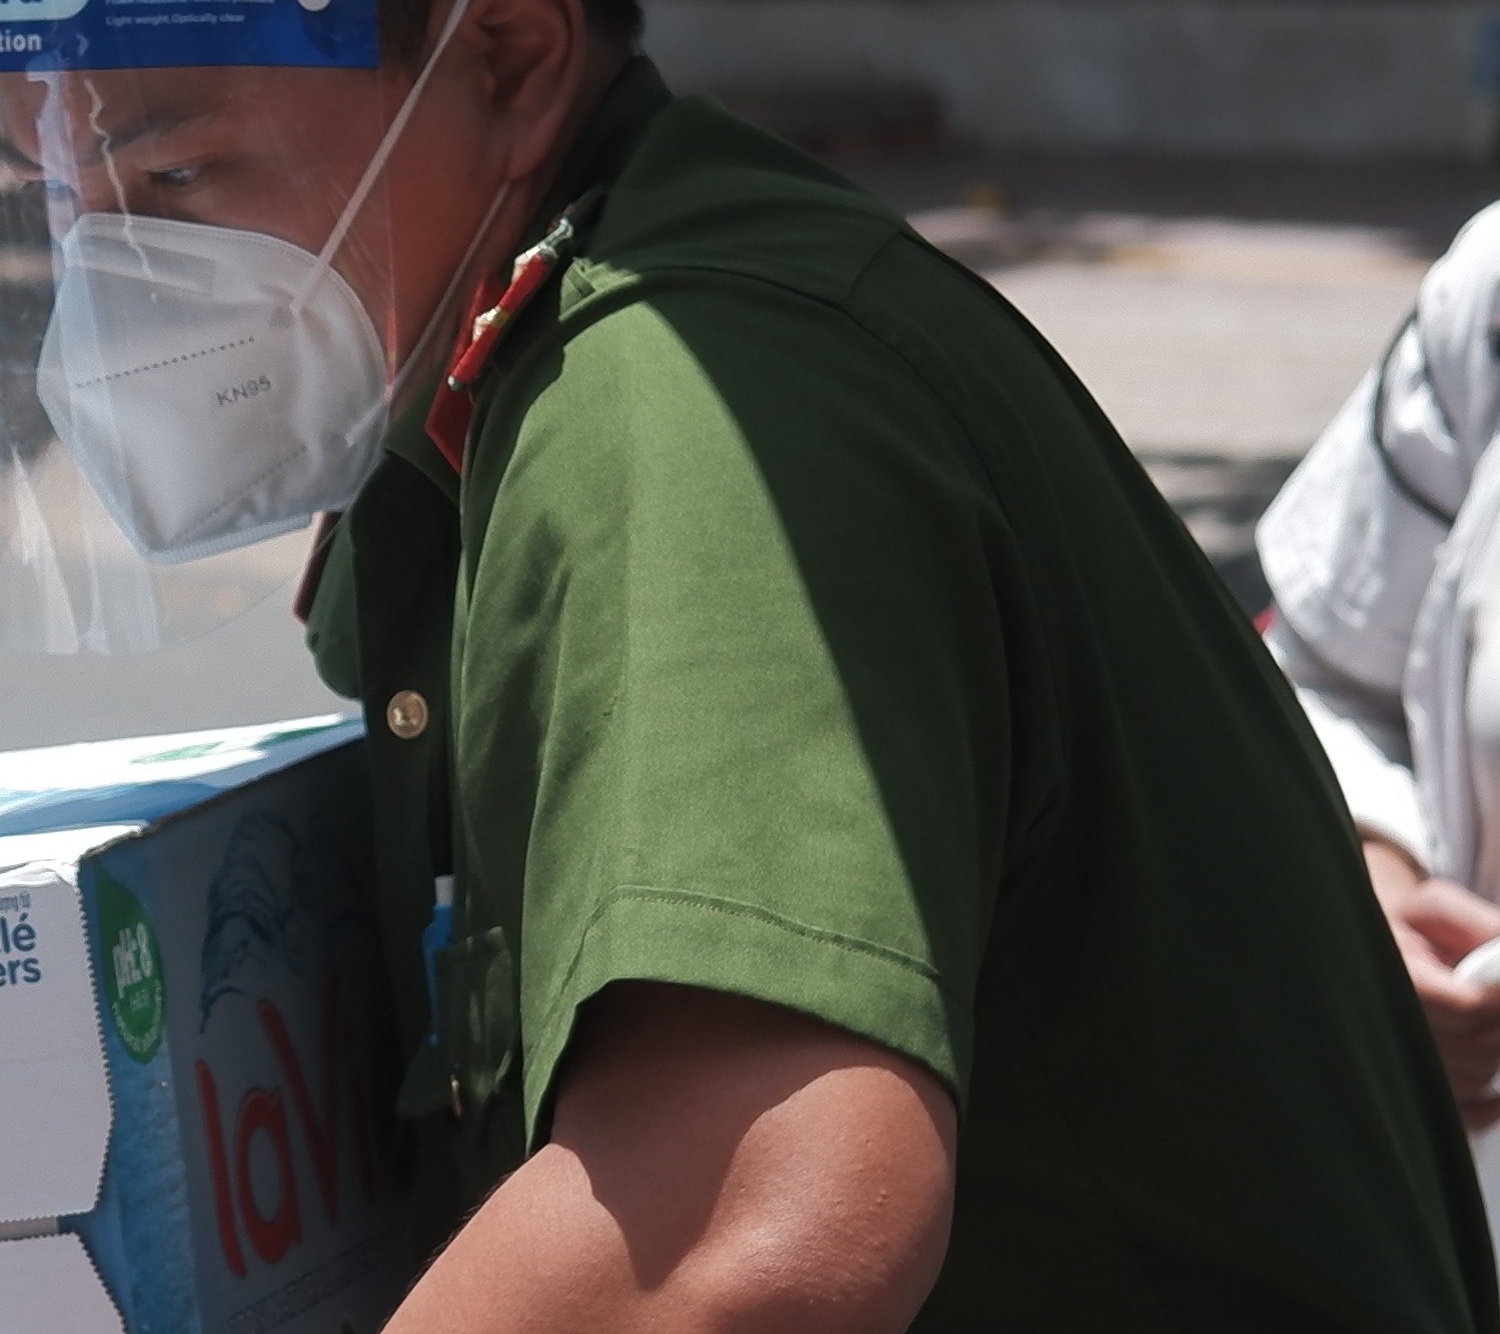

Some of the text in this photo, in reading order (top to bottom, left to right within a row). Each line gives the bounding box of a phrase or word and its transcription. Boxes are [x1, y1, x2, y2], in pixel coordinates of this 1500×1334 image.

[105, 15, 132, 27] Light
[219, 13, 245, 23] clear
[215, 375, 271, 406] KN95
